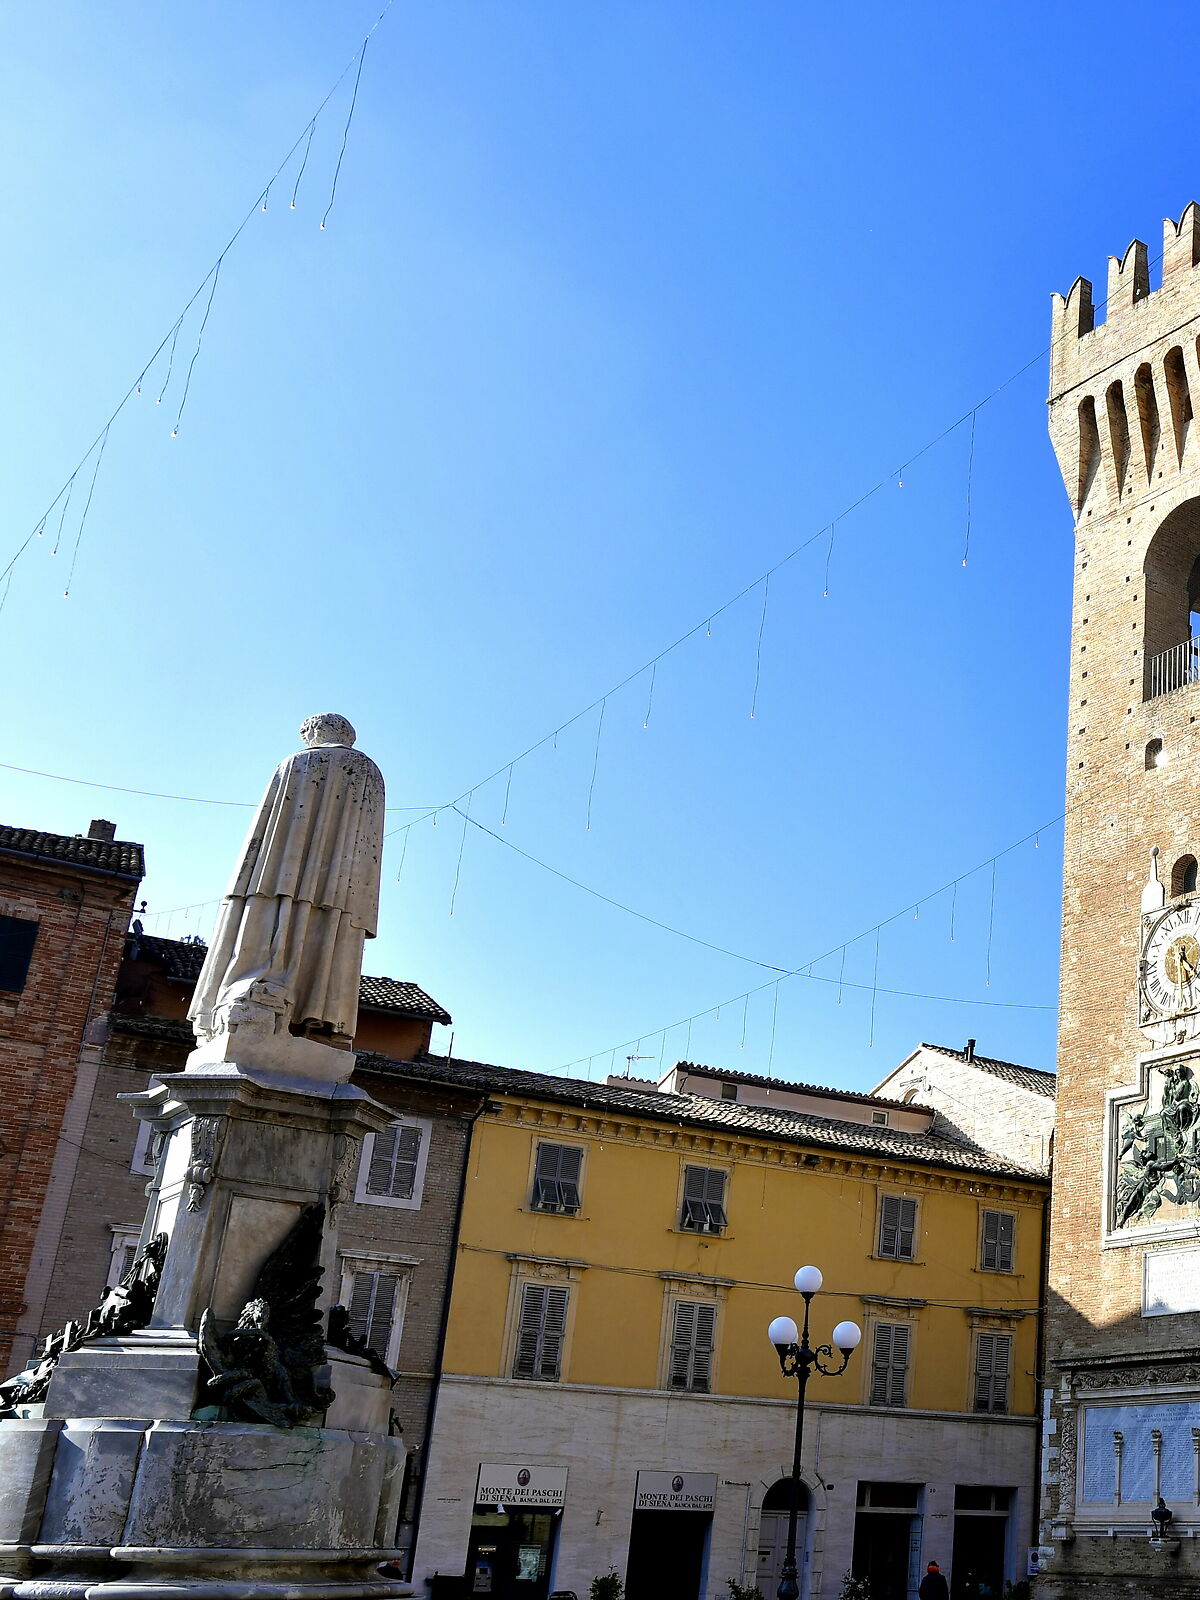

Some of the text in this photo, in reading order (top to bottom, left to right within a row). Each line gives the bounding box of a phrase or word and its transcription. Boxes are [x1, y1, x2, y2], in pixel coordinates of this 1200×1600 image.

[1160, 919, 1174, 933] XI
[1150, 940, 1163, 953] X
[1146, 960, 1158, 976] IX
[480, 1487, 563, 1497] MONTE DEI PASCHI
[639, 1493, 668, 1501] MONTE
